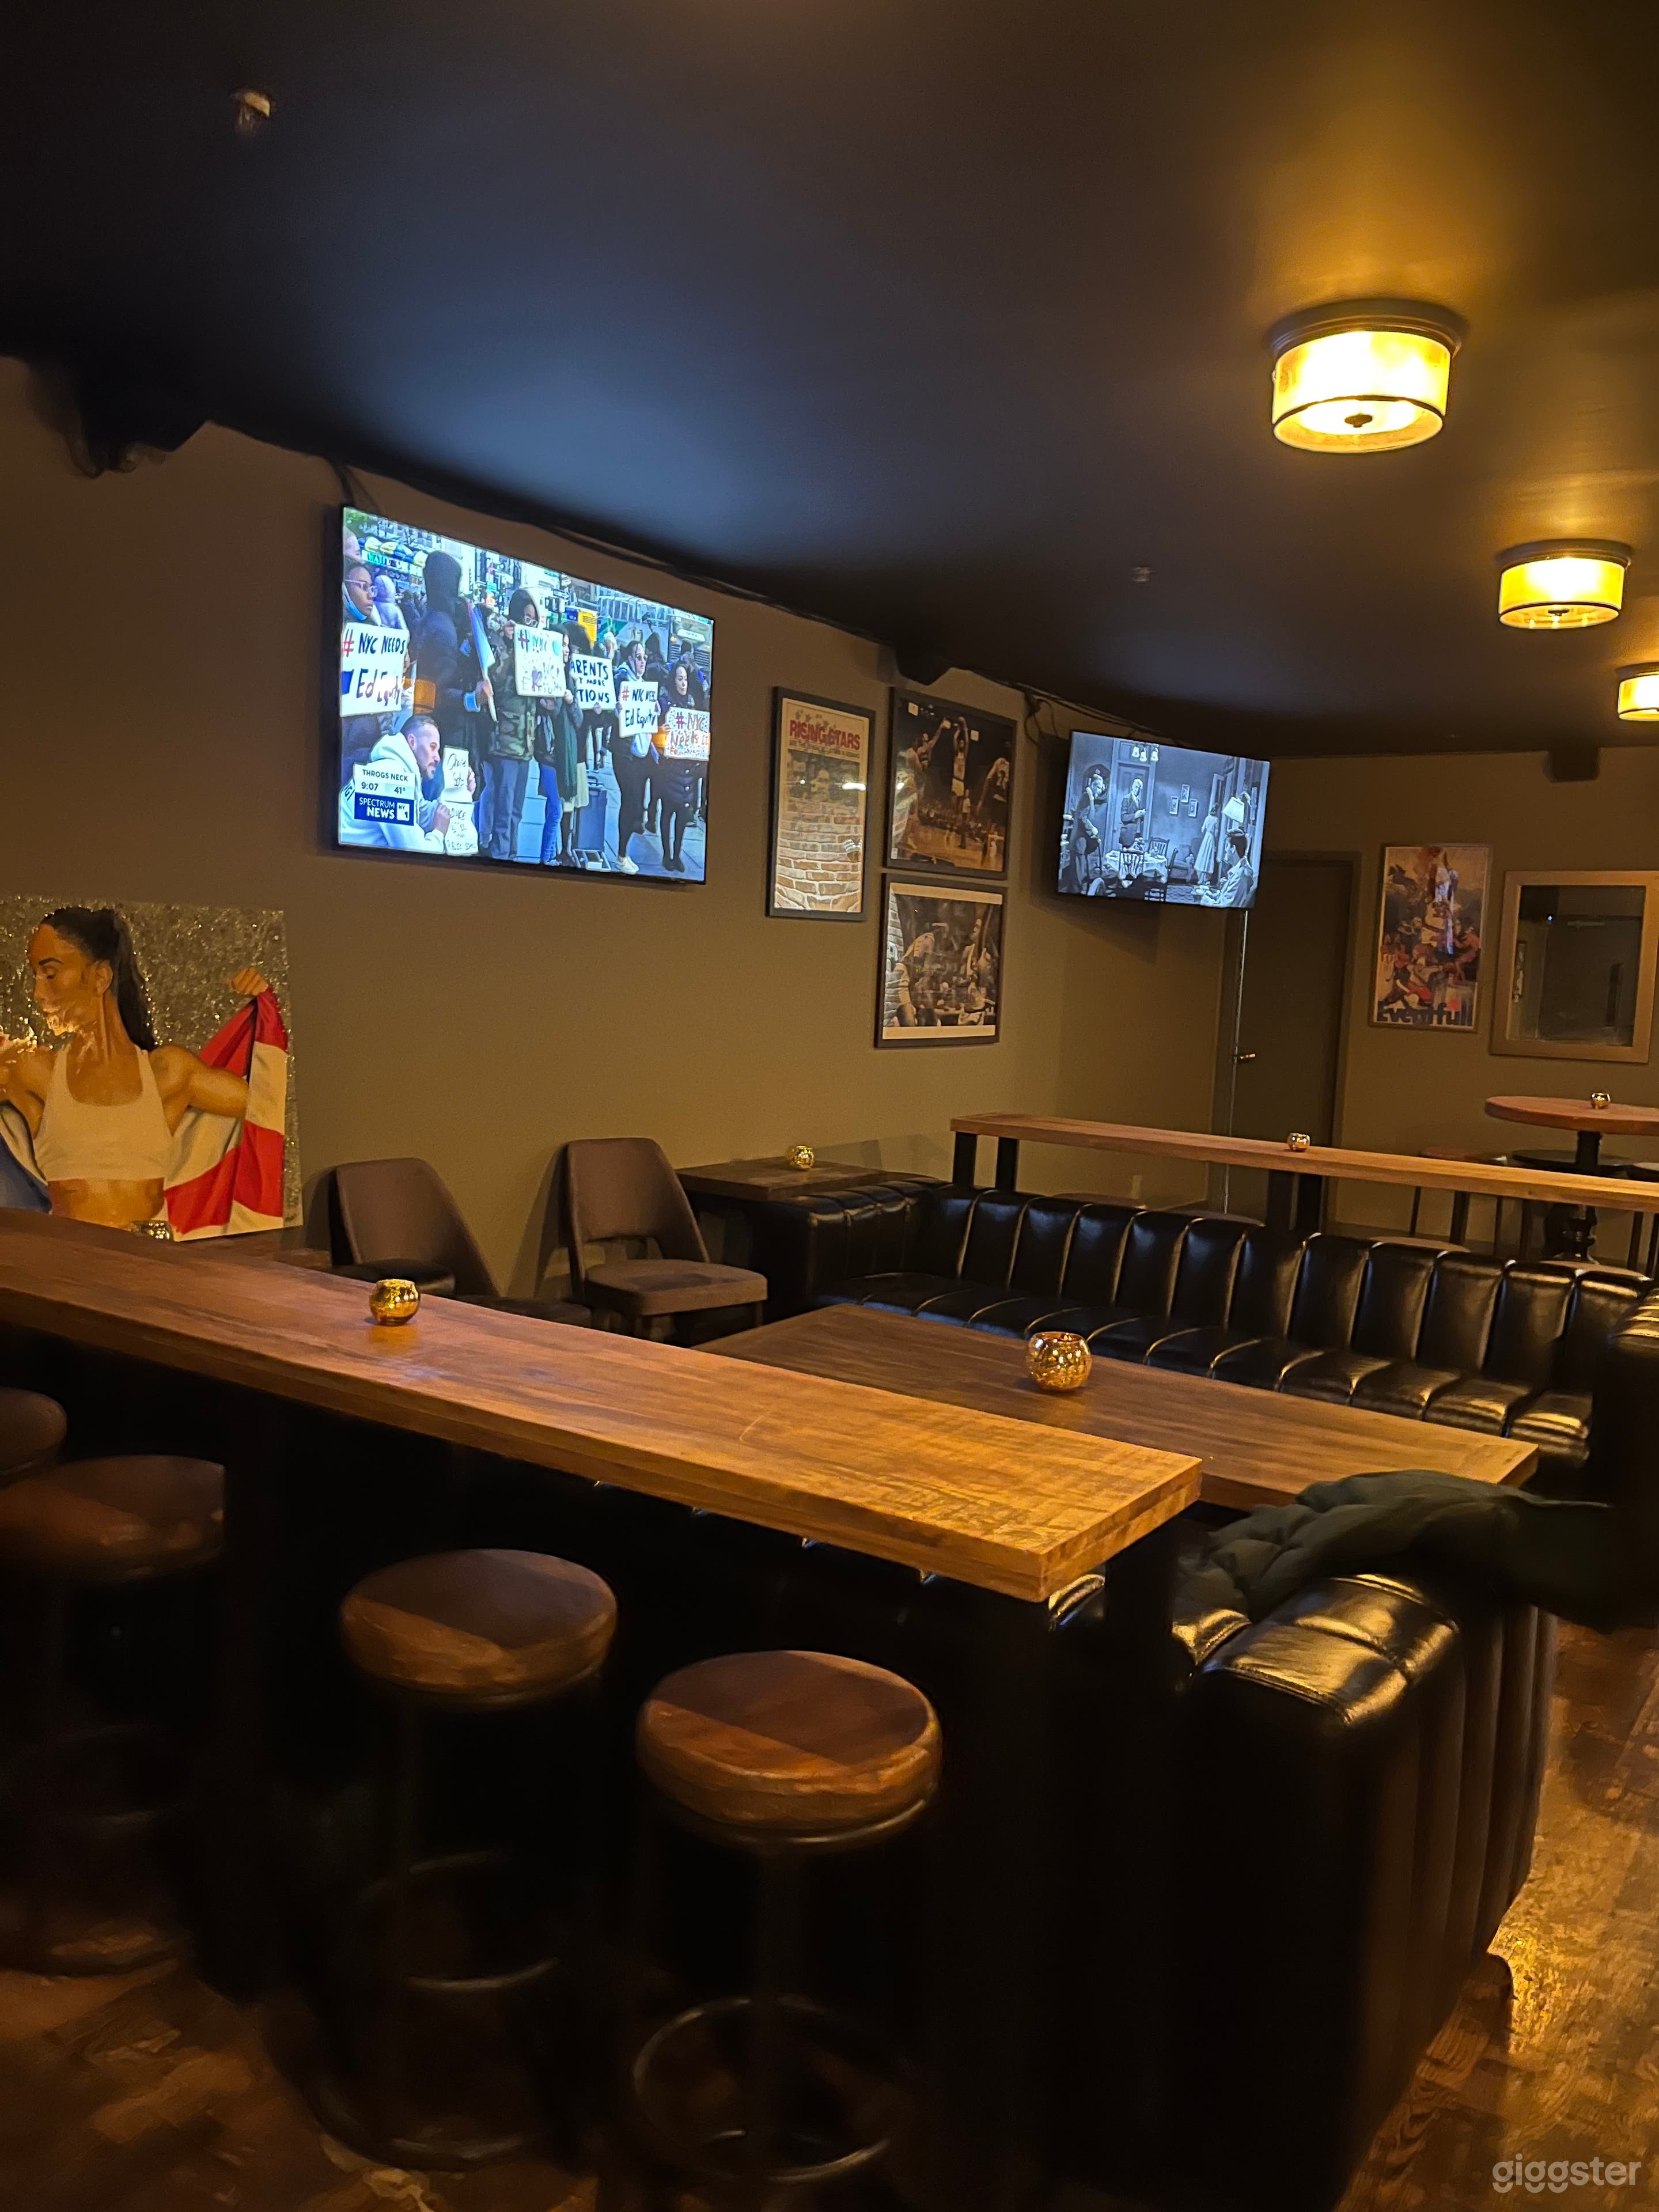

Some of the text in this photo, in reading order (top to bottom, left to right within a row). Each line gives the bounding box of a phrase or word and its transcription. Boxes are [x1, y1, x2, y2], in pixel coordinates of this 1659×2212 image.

[381, 635, 406, 654] NEEDS
[356, 668, 378, 698] Ed
[625, 708, 634, 727] Ed
[789, 719, 825, 744] RISING
[827, 728, 860, 751] STARS
[362, 768, 408, 782] THROGS NECK
[361, 782, 378, 791] 9:07
[359, 797, 395, 809] SPECTRUM
[366, 806, 395, 820] NEWS
